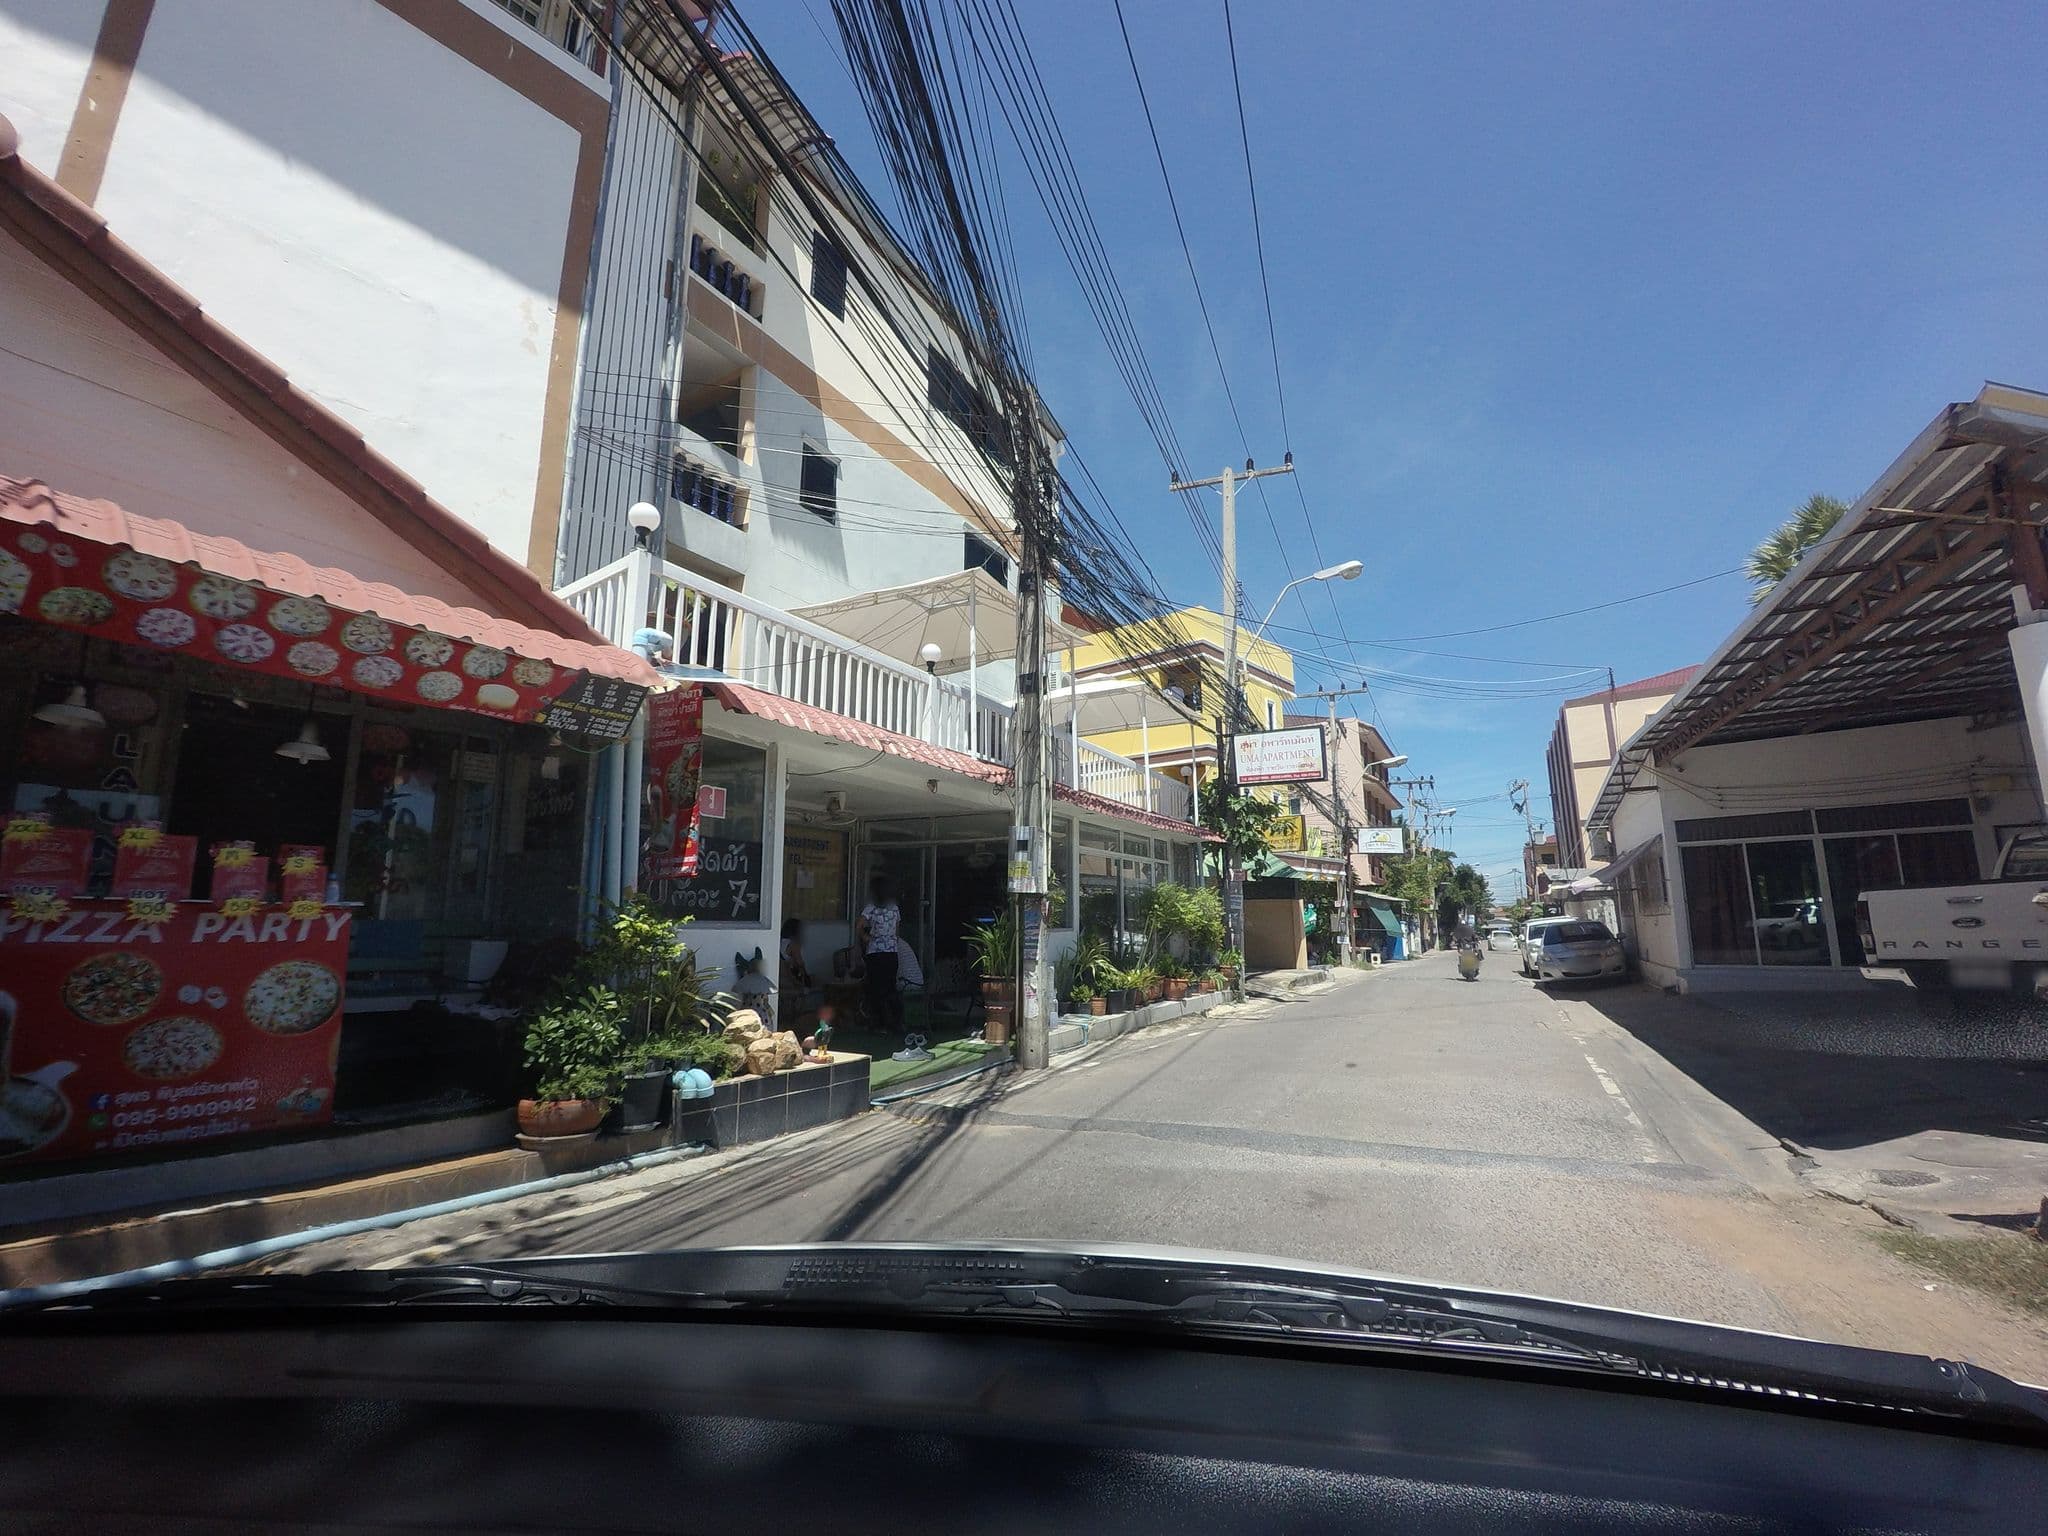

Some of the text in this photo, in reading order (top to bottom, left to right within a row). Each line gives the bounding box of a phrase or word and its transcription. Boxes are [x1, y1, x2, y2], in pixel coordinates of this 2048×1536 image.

[1240, 748, 1317, 764] UMA APARTMENT
[293, 856, 304, 869] S
[131, 888, 167, 899] HOT
[192, 912, 352, 943] PARTY
